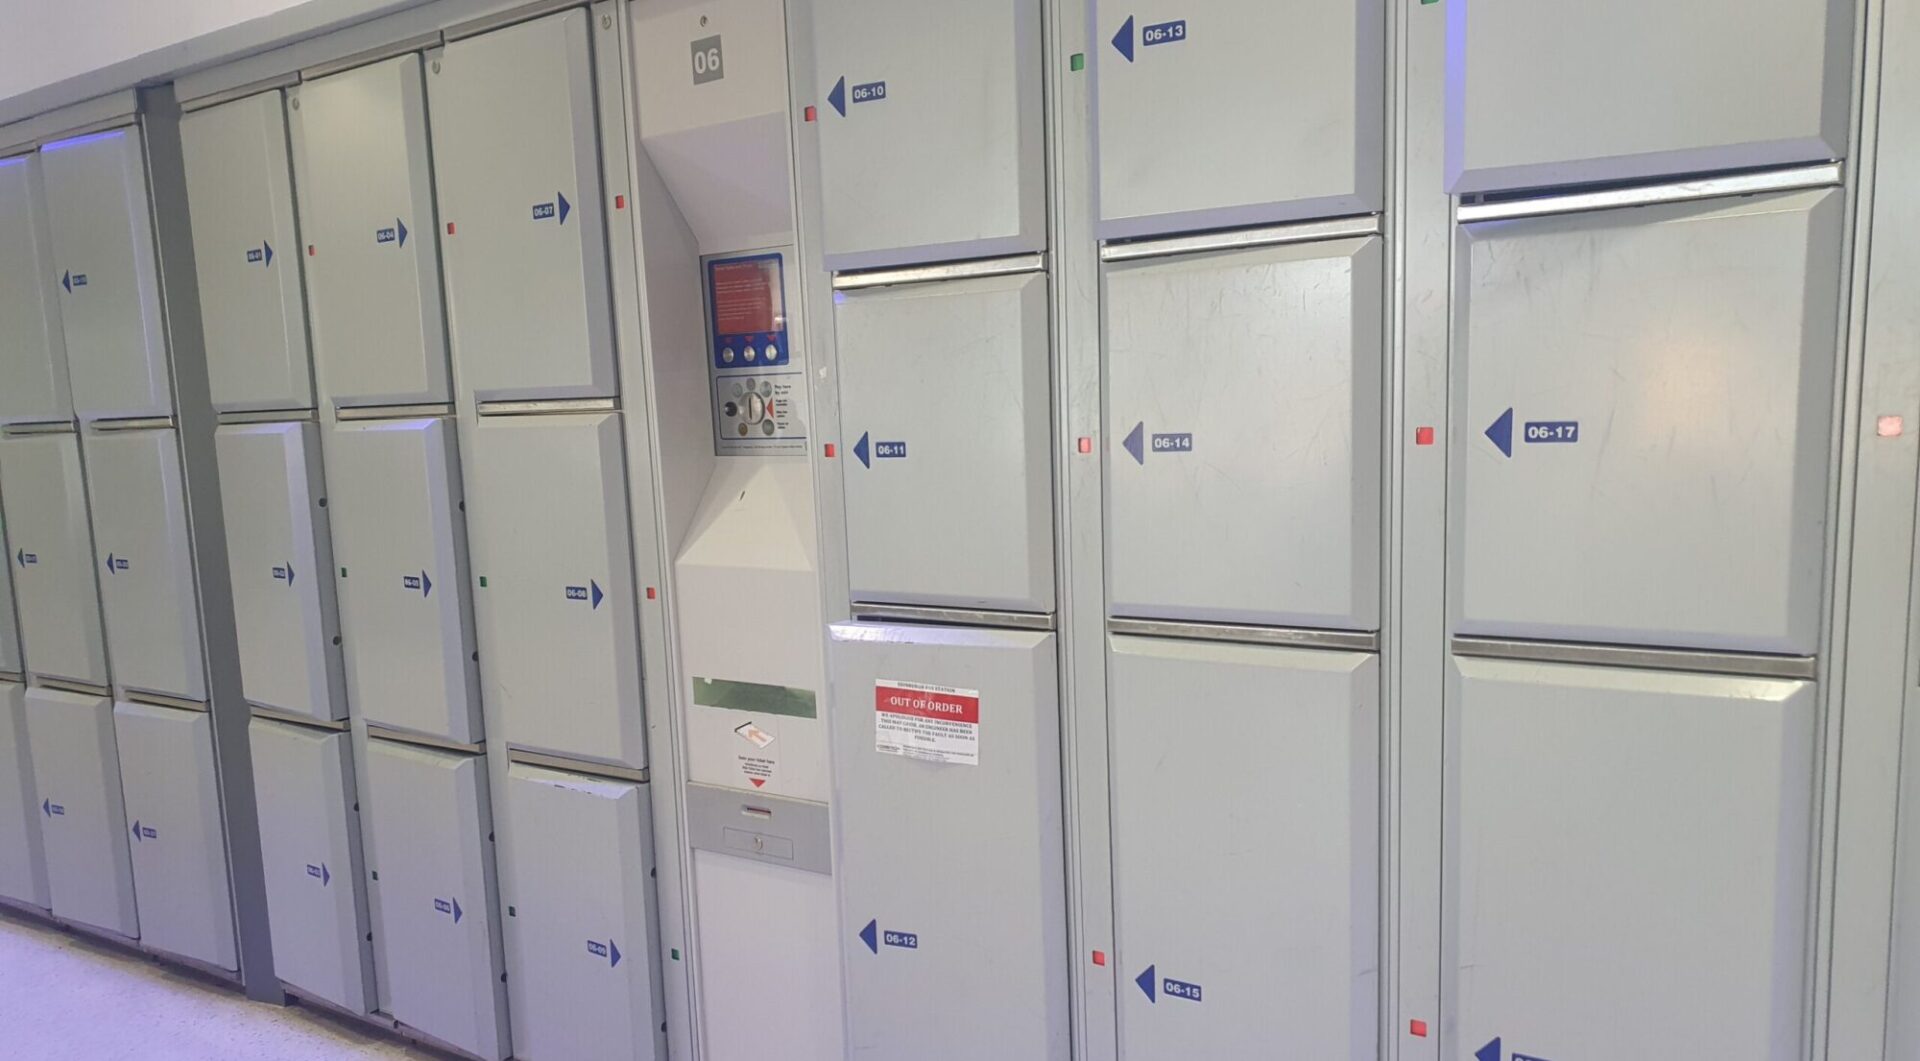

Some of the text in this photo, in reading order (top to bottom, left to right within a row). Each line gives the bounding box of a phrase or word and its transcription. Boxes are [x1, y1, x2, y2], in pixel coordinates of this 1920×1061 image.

[1145, 26, 1184, 42] 06-13
[694, 47, 720, 74] 06
[854, 85, 884, 99] 06-10
[535, 205, 553, 217] 06-07
[1528, 426, 1575, 439] 06-17
[1154, 437, 1190, 449] 06-14
[878, 444, 905, 456] 06-11
[890, 696, 963, 714] OUT OF ORDER
[886, 934, 915, 947] 06-12
[1166, 981, 1200, 998] 06-15
